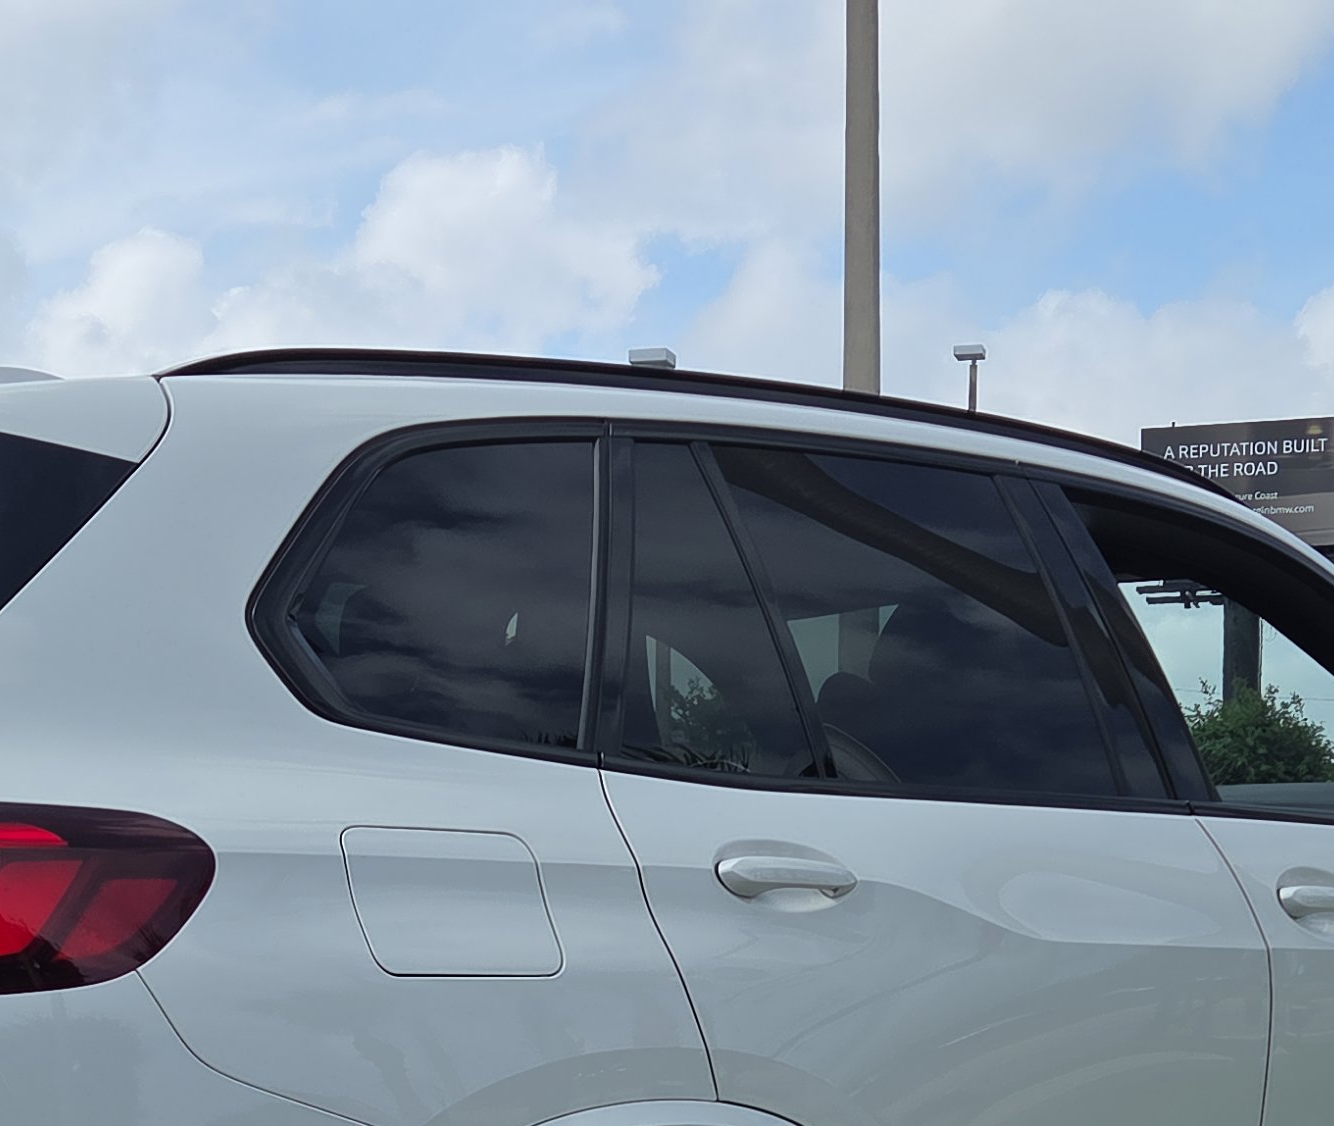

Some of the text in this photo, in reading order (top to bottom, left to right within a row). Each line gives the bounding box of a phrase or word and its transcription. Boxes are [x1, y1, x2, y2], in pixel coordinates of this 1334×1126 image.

[1163, 438, 1328, 460] A REPUTATION BUILT
[1198, 461, 1278, 478] THE ROAD
[1254, 491, 1278, 501] Coast
